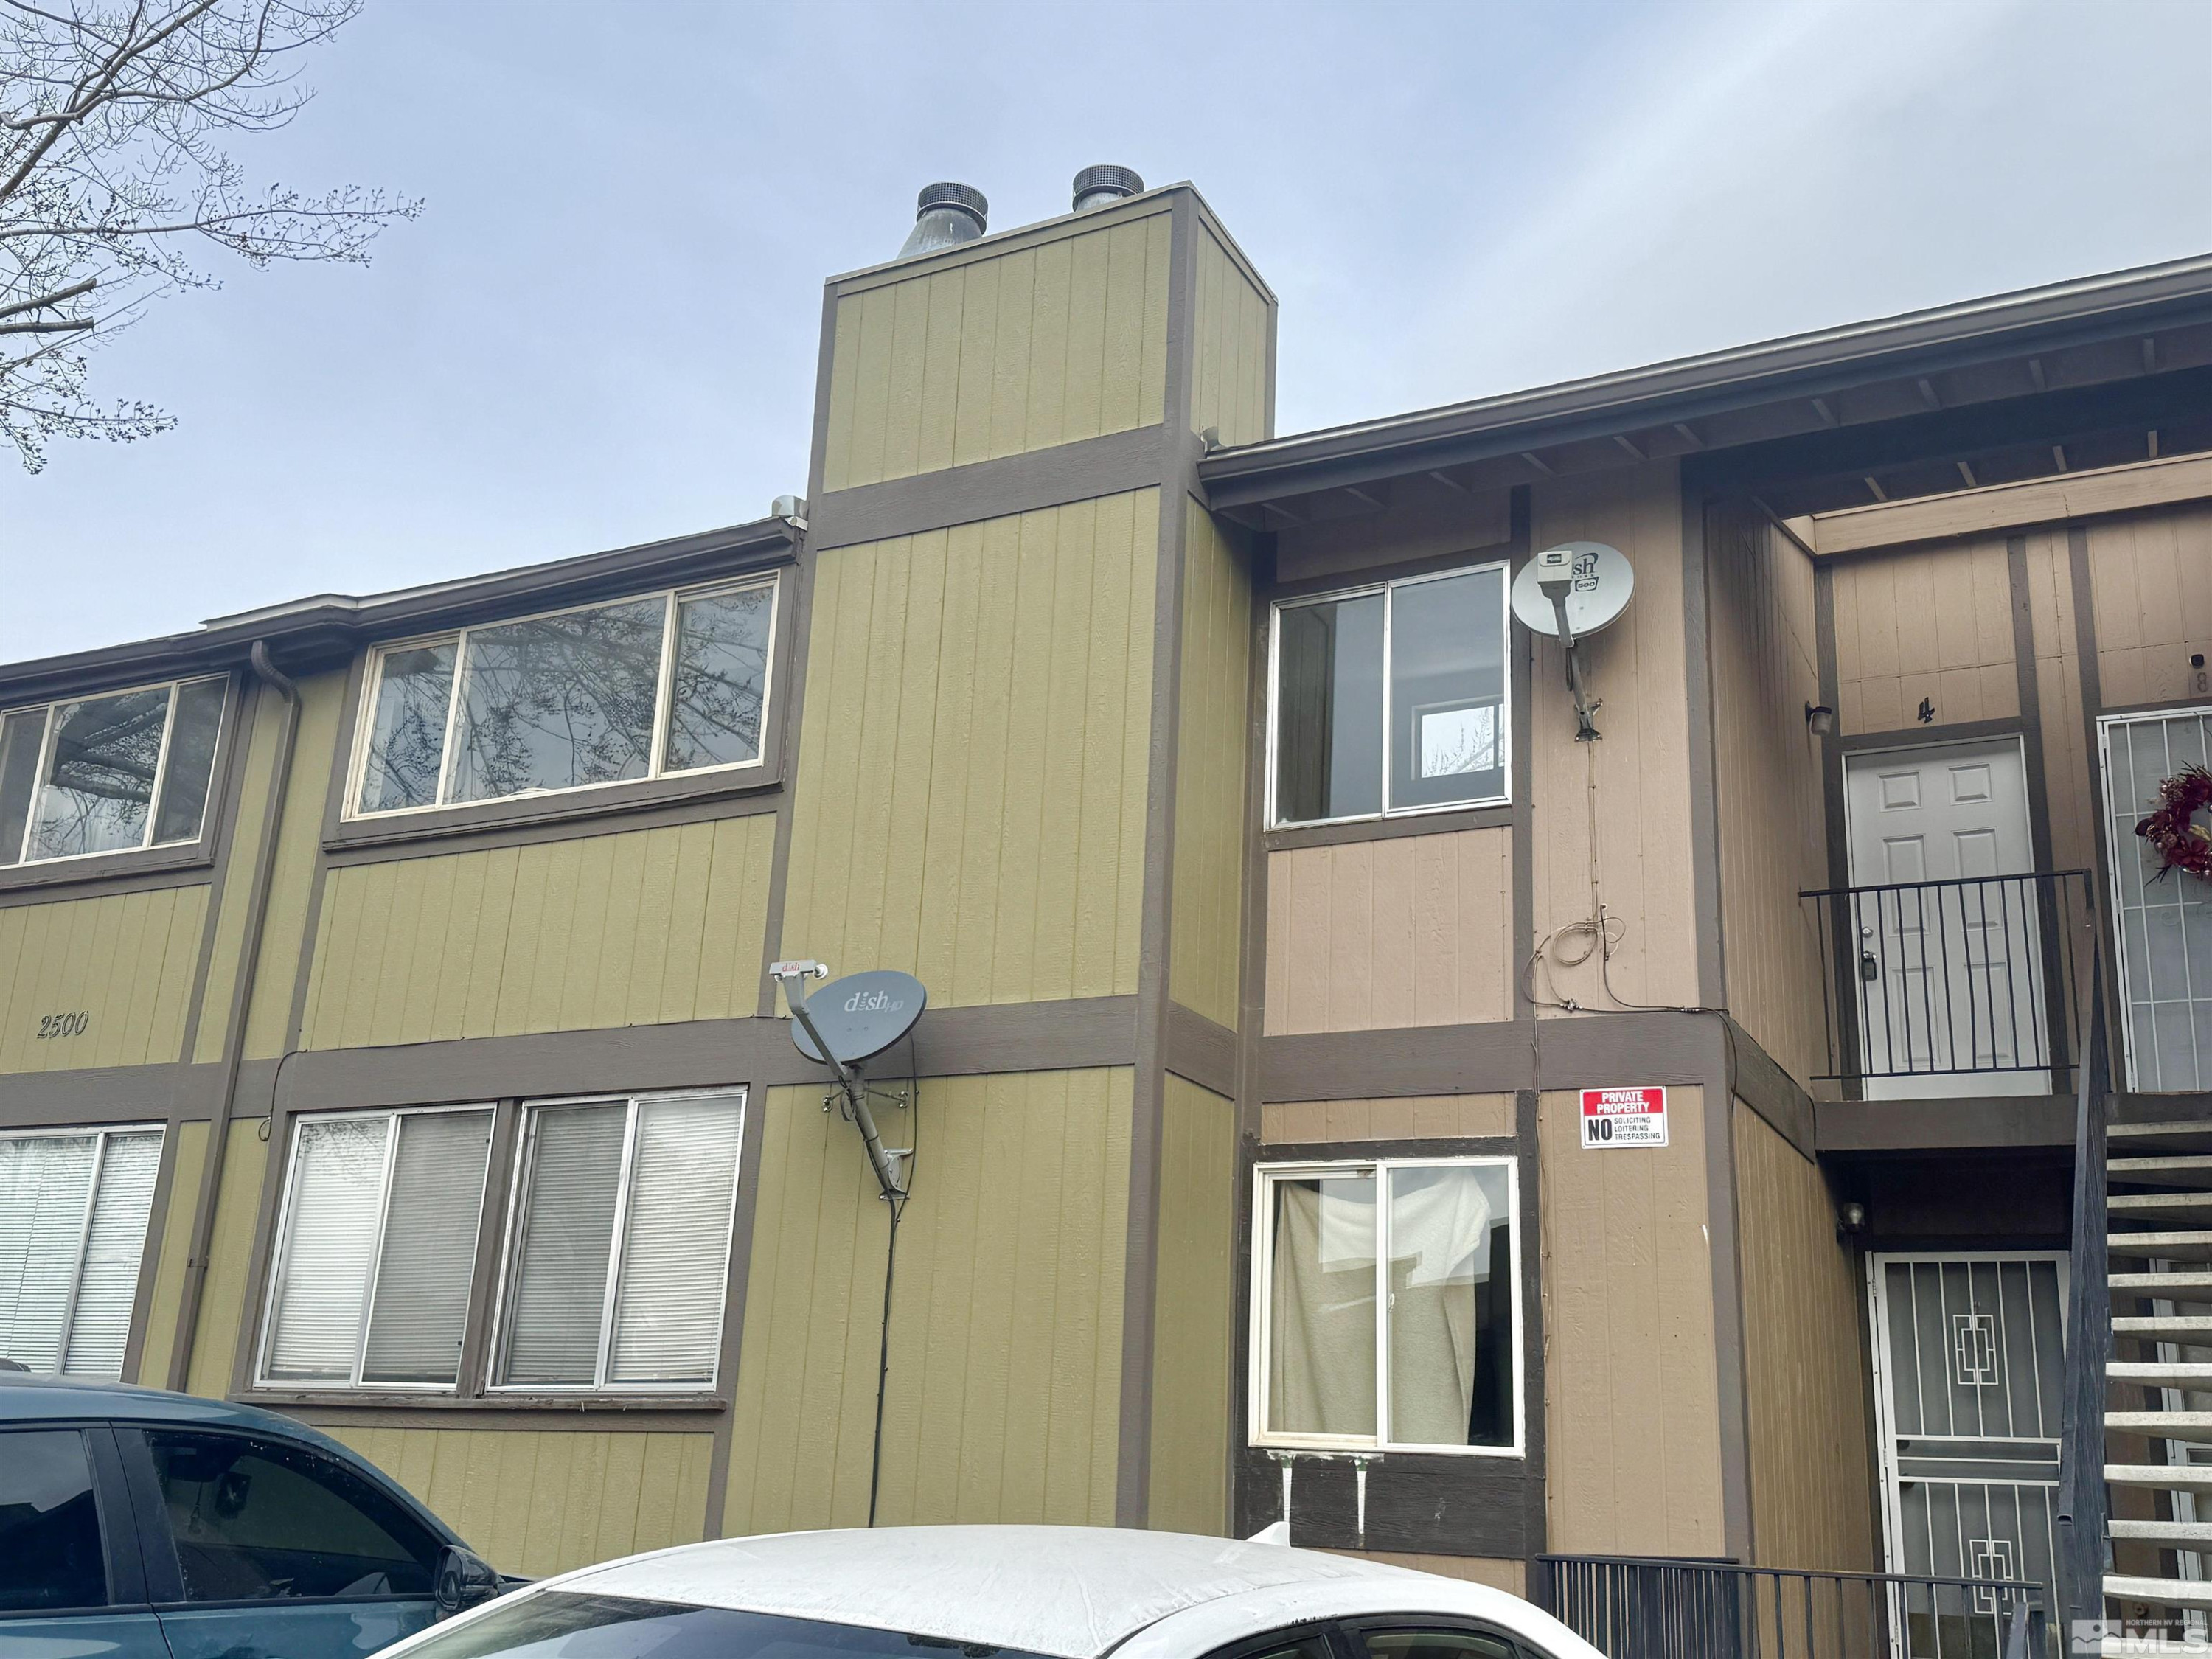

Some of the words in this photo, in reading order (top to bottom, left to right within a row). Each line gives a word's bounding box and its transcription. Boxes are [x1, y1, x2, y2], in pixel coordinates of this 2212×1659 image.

[2197, 672, 2208, 692] 8
[1918, 697, 1935, 723] 4
[782, 963, 799, 972] dish
[844, 990, 888, 1012] dish
[37, 1011, 88, 1038] 2500
[1601, 1091, 1644, 1103] PRIVATE
[1596, 1102, 1649, 1114] PROPERTY
[1614, 1116, 1651, 1124] SOLICITING
[1588, 1119, 1613, 1141] NO
[1615, 1132, 1660, 1140] TRESPASSING
